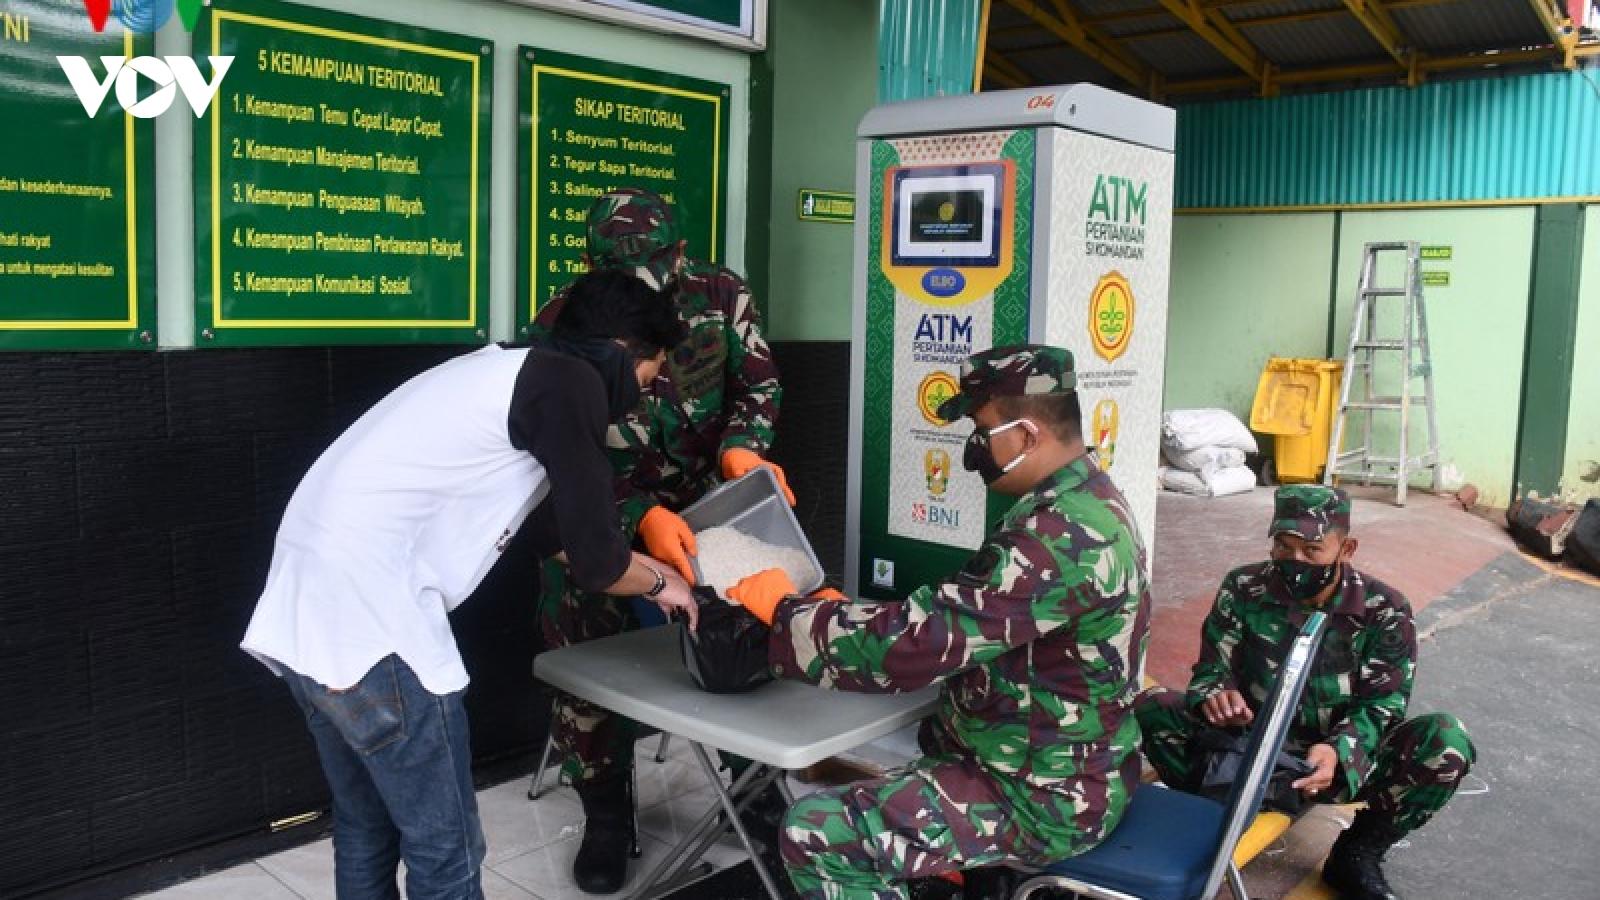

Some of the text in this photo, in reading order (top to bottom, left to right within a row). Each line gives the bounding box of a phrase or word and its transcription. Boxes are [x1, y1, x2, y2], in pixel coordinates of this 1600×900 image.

[0, 11, 30, 43] NI
[258, 49, 445, 97] 5 KEMAMPUAN TERITORIAL
[233, 92, 244, 114] 1.
[245, 93, 315, 125] Kemampuan
[352, 108, 382, 133] Cepat
[383, 111, 413, 137] Lapor
[413, 115, 445, 141] Cepat.
[575, 97, 687, 131] SIKAP TERITORIAL
[551, 127, 676, 157] 1. Senyum Teritorial.
[231, 138, 421, 175] 2. Kemampuan Manajemen Teritorial.
[549, 153, 677, 181] 2. Tegur Sapa Teritorial.
[232, 182, 426, 219] 3. Kemampuan Penguasaan Wilayah.
[549, 180, 561, 195] 3.
[1086, 173, 1148, 226] ATM
[549, 207, 561, 221] 4.
[21, 234, 51, 251] rakyat
[232, 227, 465, 261] 4. Kemampuan Pembinaan Perlawanan Rakyat.
[549, 233, 561, 247] 5.
[1085, 221, 1145, 245] PERTANIAN
[549, 259, 561, 273] 6.
[233, 271, 413, 298] 5. Kemampuan Komunikasi Sosial.
[913, 313, 973, 343] ATM
[912, 342, 973, 355] PERTANIAN
[921, 354, 965, 365] KOMANDA
[928, 505, 960, 528] BNI
